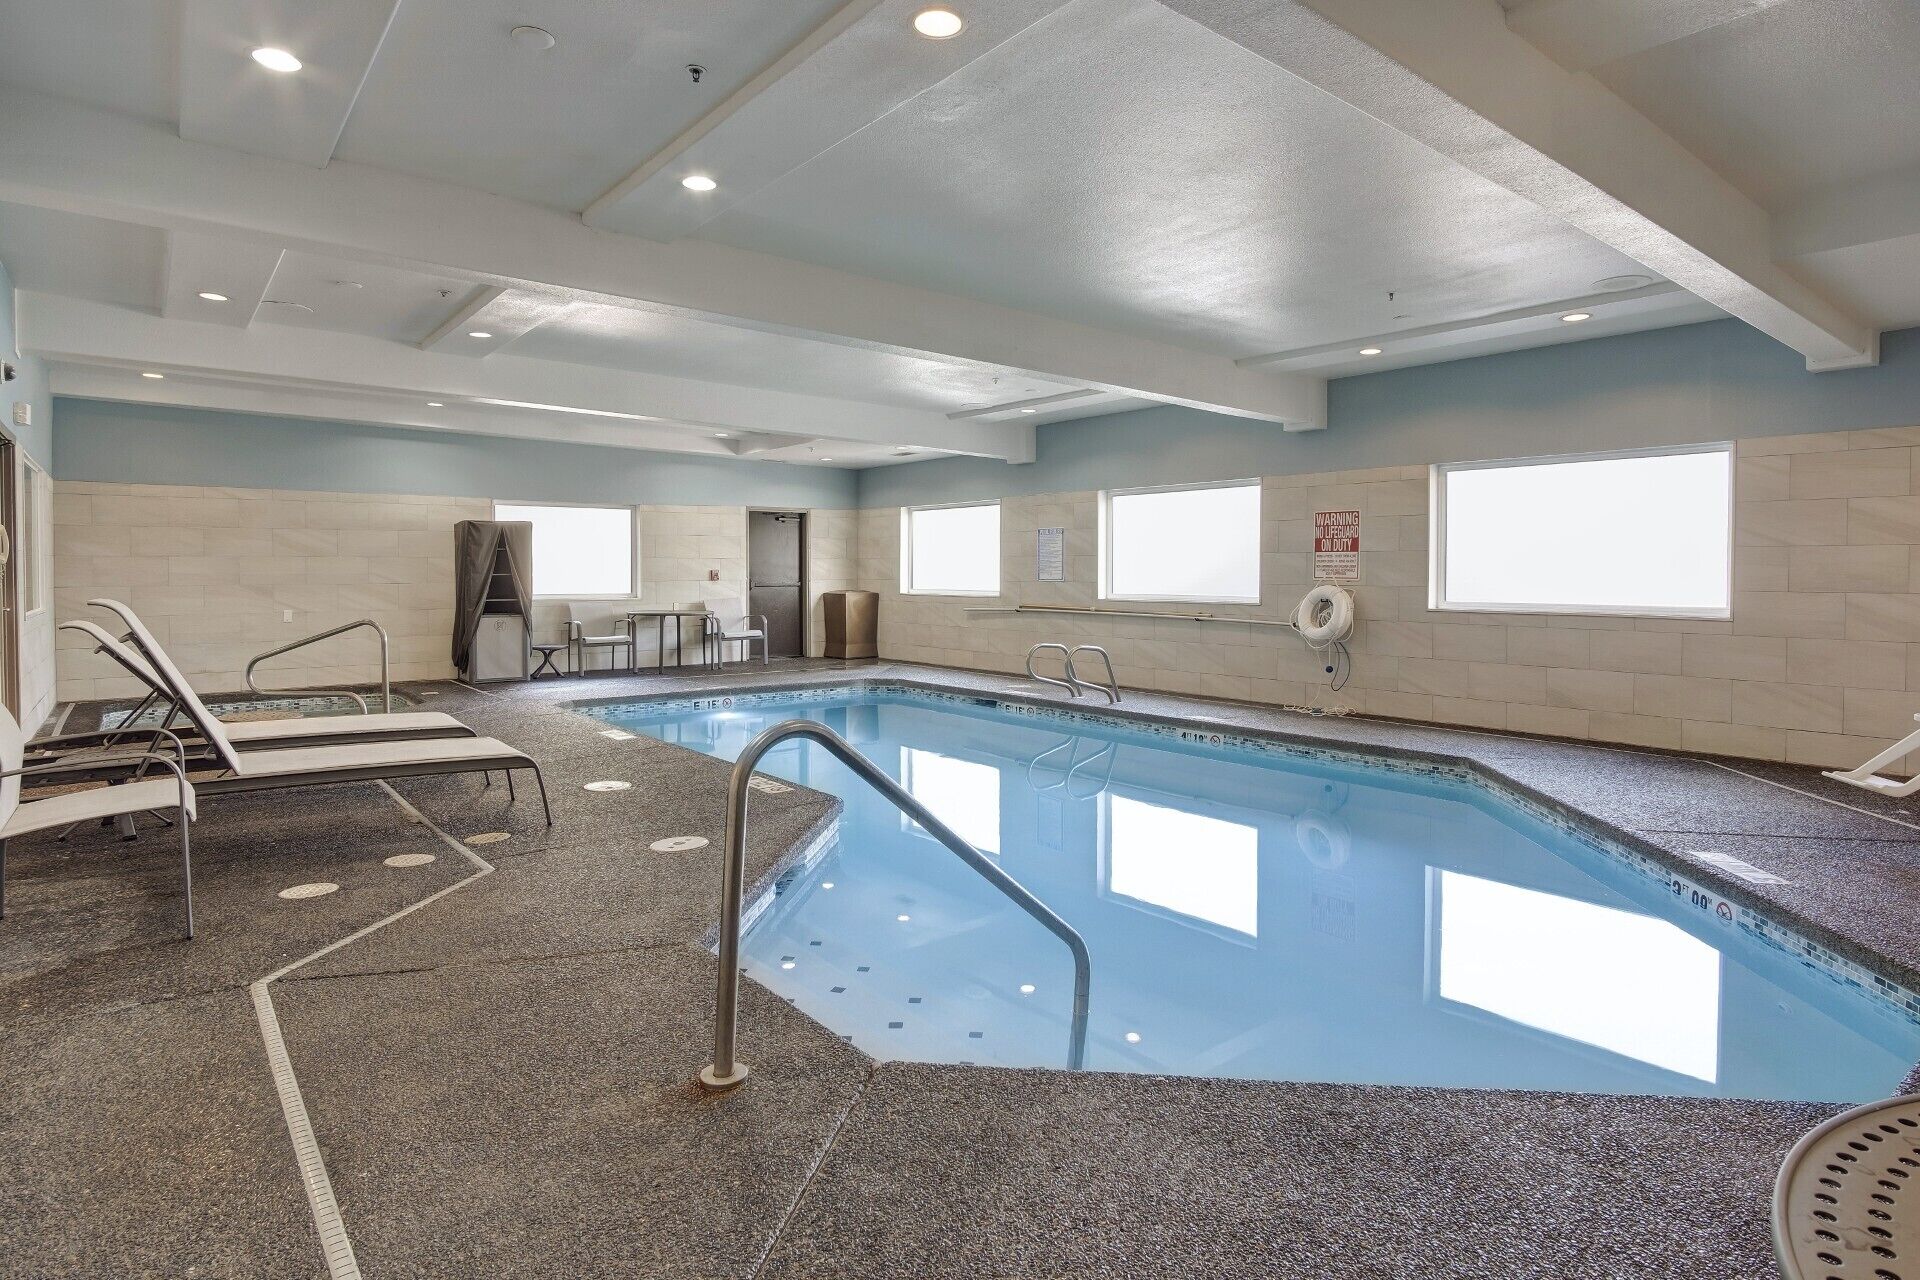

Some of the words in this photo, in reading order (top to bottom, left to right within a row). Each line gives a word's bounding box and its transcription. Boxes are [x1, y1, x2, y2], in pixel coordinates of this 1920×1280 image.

[1316, 512, 1358, 525] WARNING
[1315, 526, 1324, 539] NO
[1325, 525, 1358, 538] LIFEGUARD
[1321, 538, 1332, 551] ON
[1333, 538, 1352, 551] DUTY
